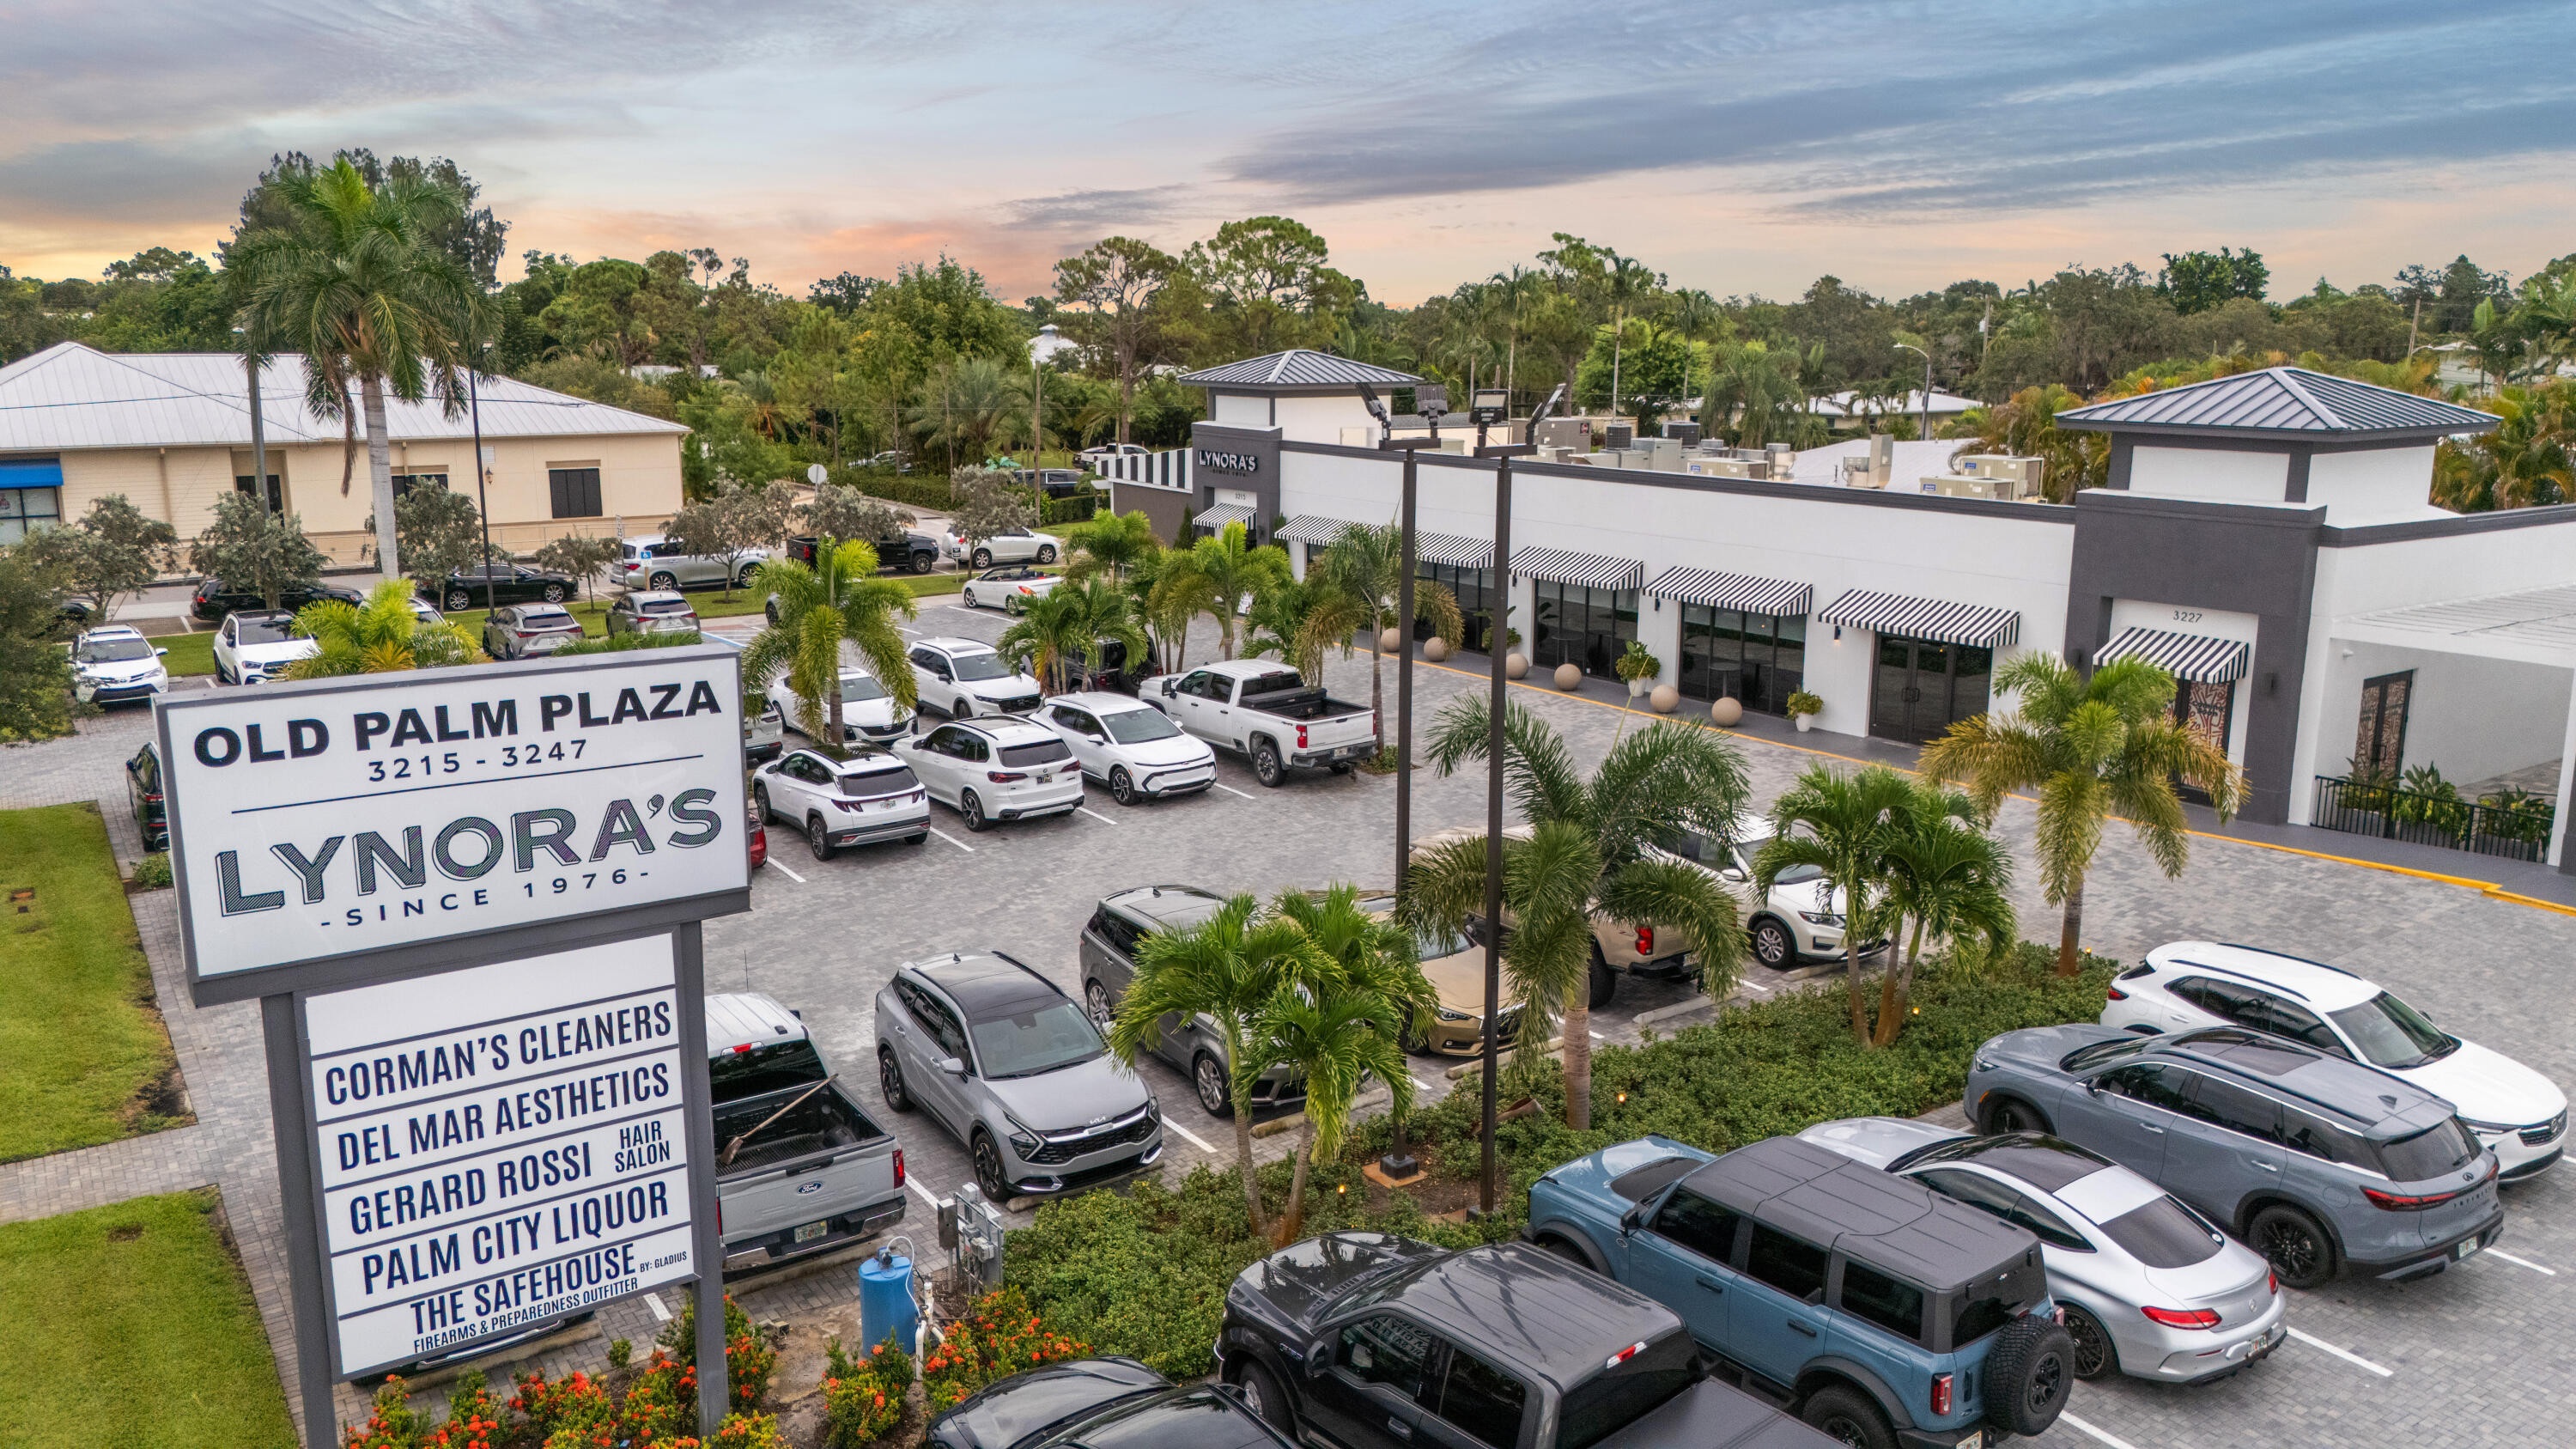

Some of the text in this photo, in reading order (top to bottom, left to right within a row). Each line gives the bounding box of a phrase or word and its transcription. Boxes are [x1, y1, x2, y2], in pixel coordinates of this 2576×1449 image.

[1199, 451, 1256, 472] LYNORA'S
[2173, 610, 2202, 623] 3227
[194, 680, 721, 767] OLD PALM PLAZA
[369, 752, 459, 782] 3215
[502, 740, 586, 767] 3247
[215, 788, 721, 917] LYNORA'S
[326, 1002, 671, 1105] CORMAN'S CLEANERS
[338, 1062, 669, 1171] DEL MAR AESTHETICS
[620, 1121, 661, 1149] HAIR
[350, 1142, 591, 1234] GERARD ROSSI
[615, 1141, 670, 1172] SALON
[802, 1183, 818, 1193] Ford
[362, 1181, 668, 1295] PALM CITY LIQUOR
[641, 1251, 687, 1273] BY: GLADIUS
[410, 1243, 635, 1335] THE SAFEHOUSE
[414, 1278, 638, 1354] FIREARMS & PREPAREDNESS OUTFITTER
